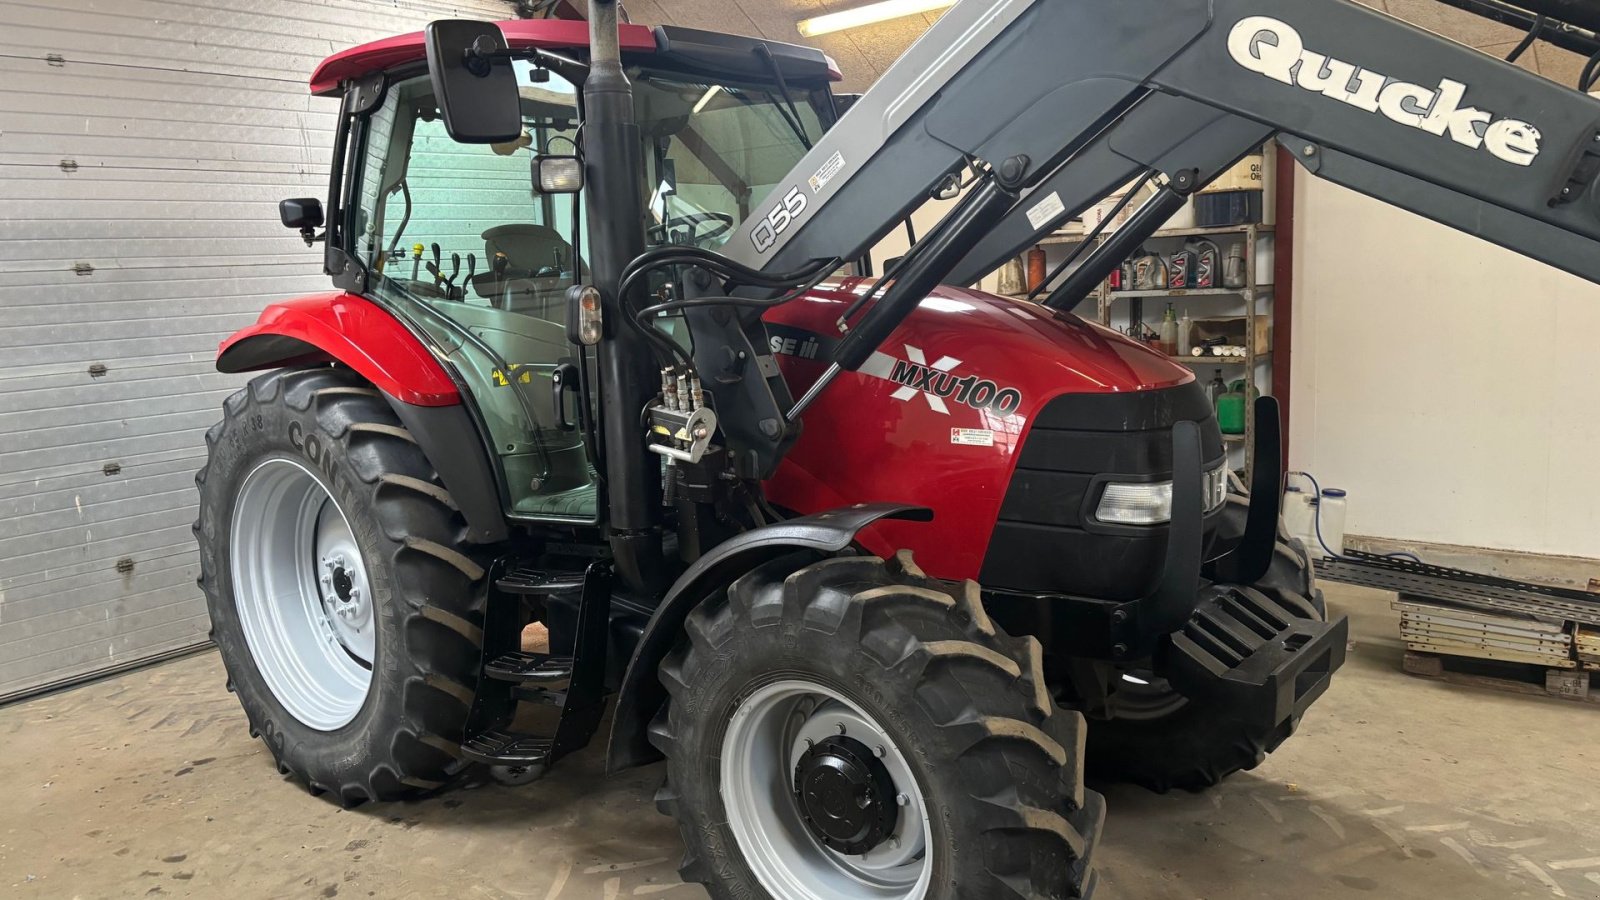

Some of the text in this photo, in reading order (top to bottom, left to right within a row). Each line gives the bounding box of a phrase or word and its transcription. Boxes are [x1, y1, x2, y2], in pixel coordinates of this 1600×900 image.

[1227, 15, 1542, 166] Quicke
[749, 184, 808, 254] Q55
[770, 335, 797, 355] SE
[891, 360, 1022, 418] MXU100
